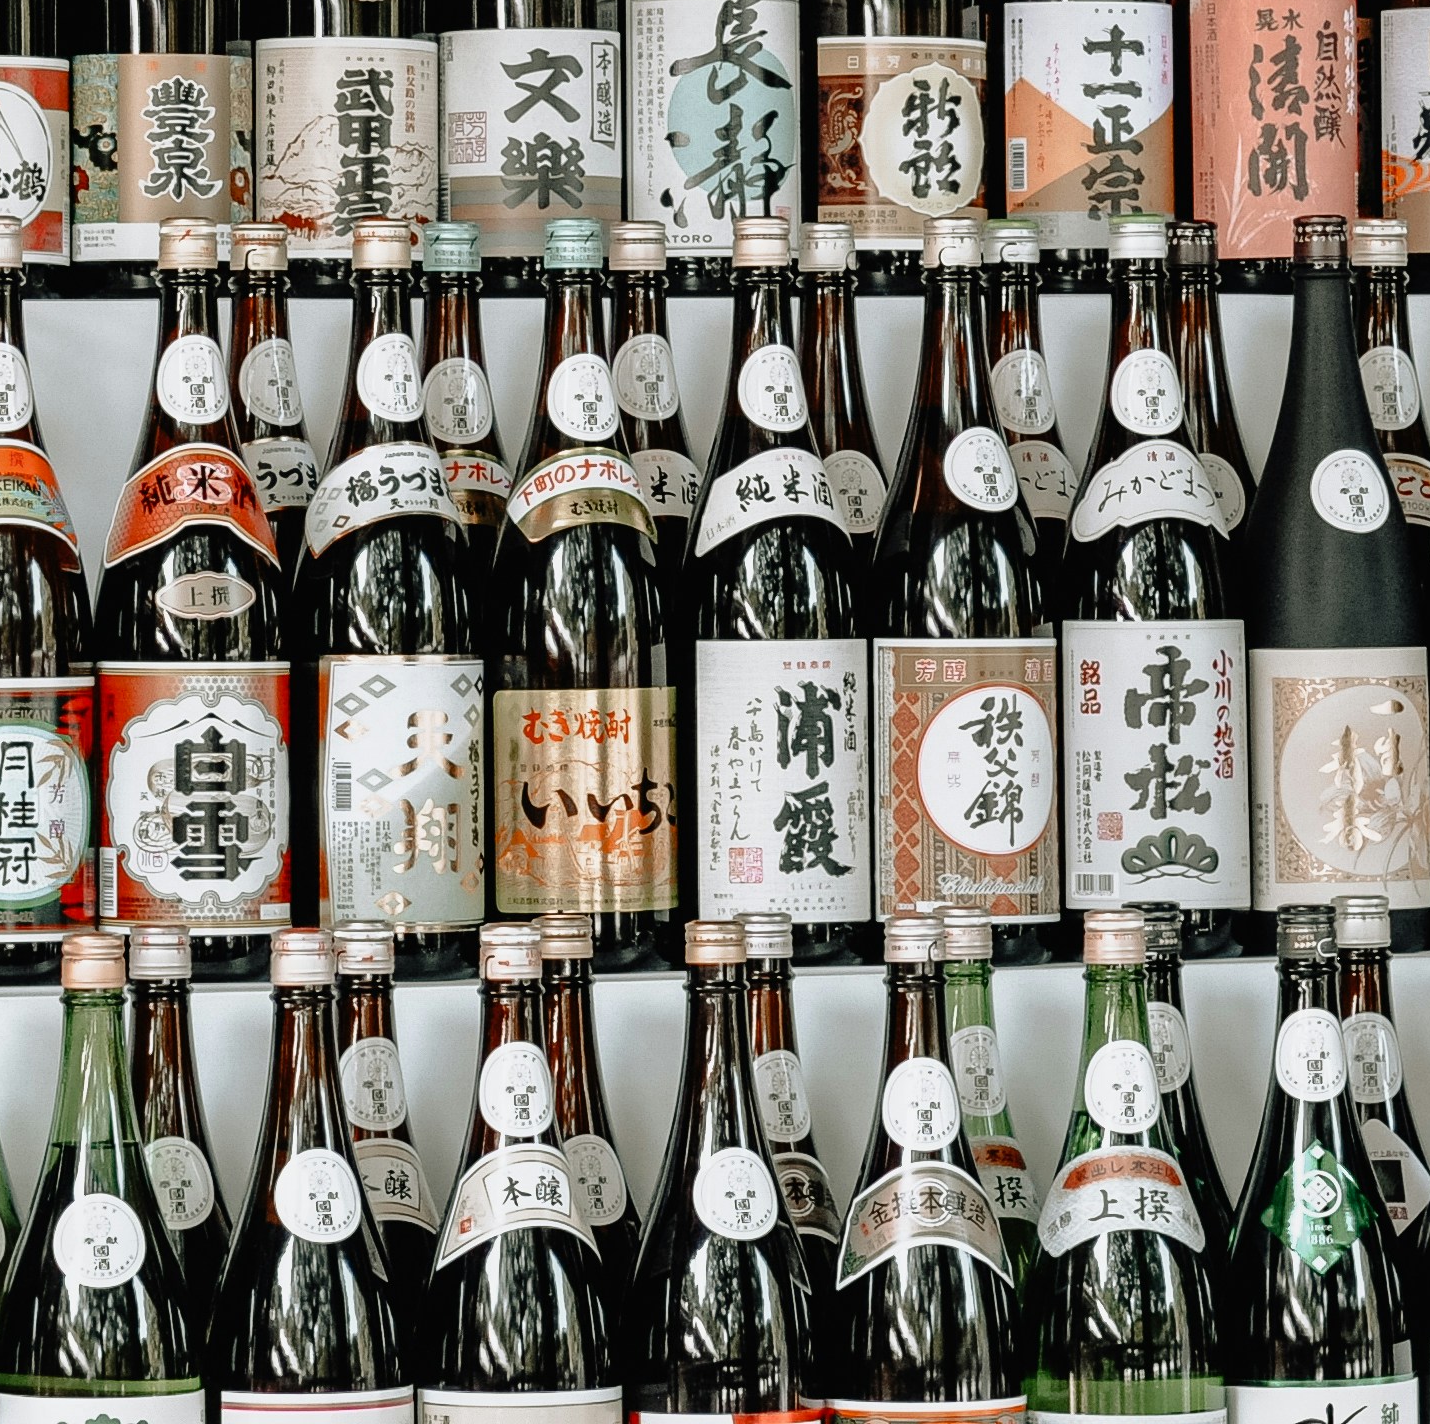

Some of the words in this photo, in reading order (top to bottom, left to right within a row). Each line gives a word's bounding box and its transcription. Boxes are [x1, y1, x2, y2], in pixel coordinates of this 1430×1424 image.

[1206, 1, 1217, 43] 日本酒
[404, 65, 416, 134] 秩父路の銘酒
[594, 54, 615, 138] 本醸造
[1311, 20, 1347, 148] 自然醸
[499, 47, 587, 212] 文樂
[1080, 23, 1146, 219] 十一正宗
[139, 461, 259, 517] 純米酒
[569, 499, 619, 516] むぎ焼酎
[735, 465, 834, 513] 純米酒
[1098, 459, 1217, 514] みかどまつ
[183, 585, 232, 608] 上撰
[914, 659, 967, 682] 芳醇
[1079, 659, 1102, 716] 銘品
[522, 709, 632, 745] むぎ焼酎
[1123, 644, 1211, 822] 帝松
[1211, 648, 1235, 781] 小川の地酒
[771, 680, 854, 877] 浦霞
[958, 693, 1025, 848] 秩父錦
[48, 783, 67, 840] 芳醇
[169, 725, 266, 881] 白雪
[380, 819, 391, 853] 日本酒
[1088, 1187, 1174, 1222] 上撰
